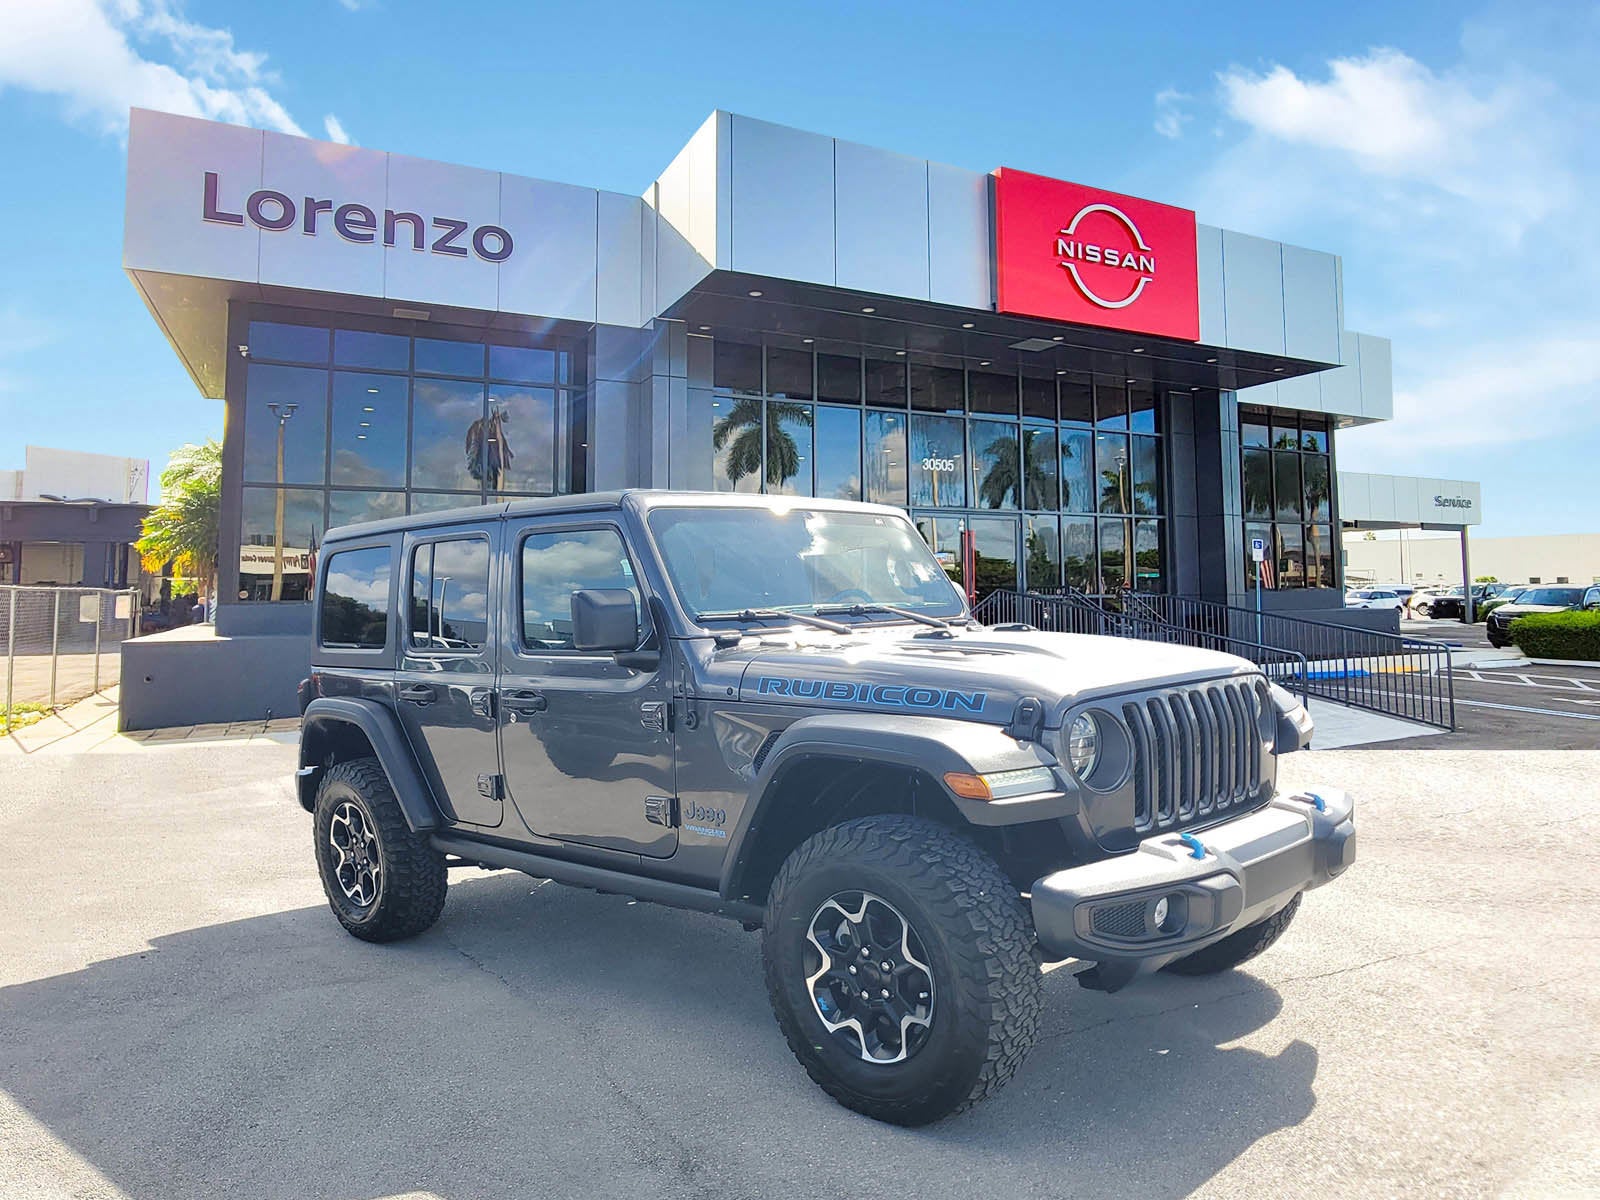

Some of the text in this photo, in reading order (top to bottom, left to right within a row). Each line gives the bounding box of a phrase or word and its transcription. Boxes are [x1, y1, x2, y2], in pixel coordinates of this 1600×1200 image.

[202, 171, 514, 262] Lorenzo
[1057, 238, 1155, 273] NISSAN
[922, 458, 954, 471] 30505
[1434, 495, 1472, 509] Service
[757, 676, 988, 712] RUBICON
[685, 800, 727, 827] Jeep
